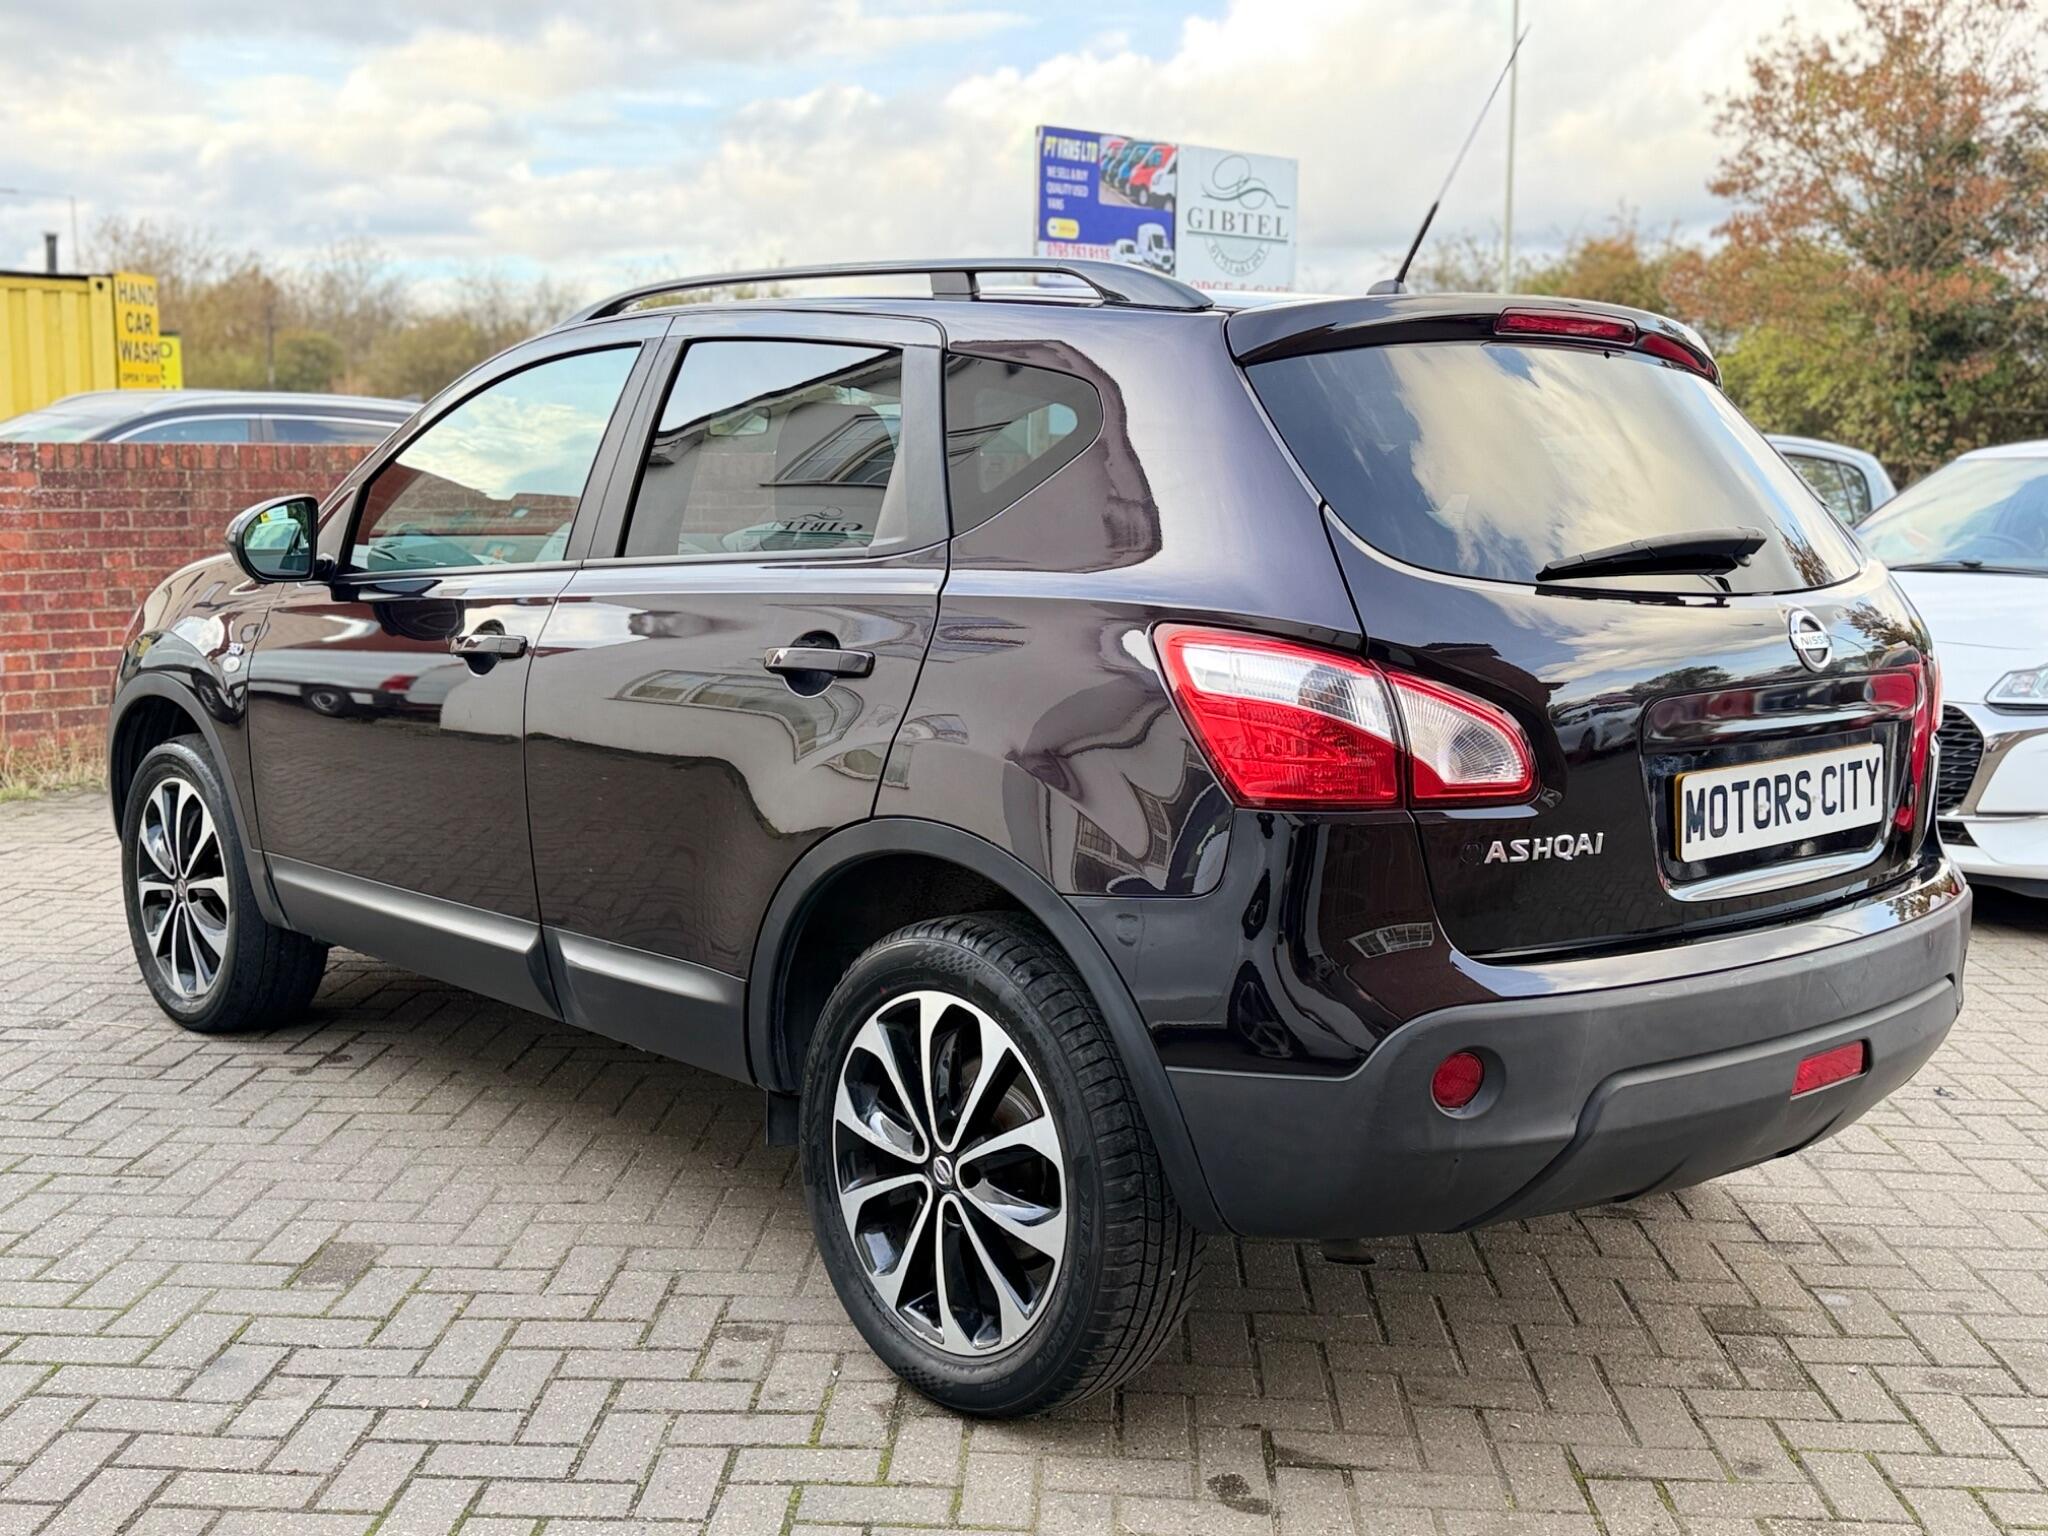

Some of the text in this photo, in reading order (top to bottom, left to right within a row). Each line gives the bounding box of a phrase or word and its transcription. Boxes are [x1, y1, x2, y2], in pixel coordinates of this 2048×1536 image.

[1187, 206, 1288, 238] GIBTEL
[118, 281, 155, 307] HAND
[125, 312, 153, 336] CAR
[120, 340, 160, 363] WASH
[1685, 757, 1881, 844] MOTORS CITY
